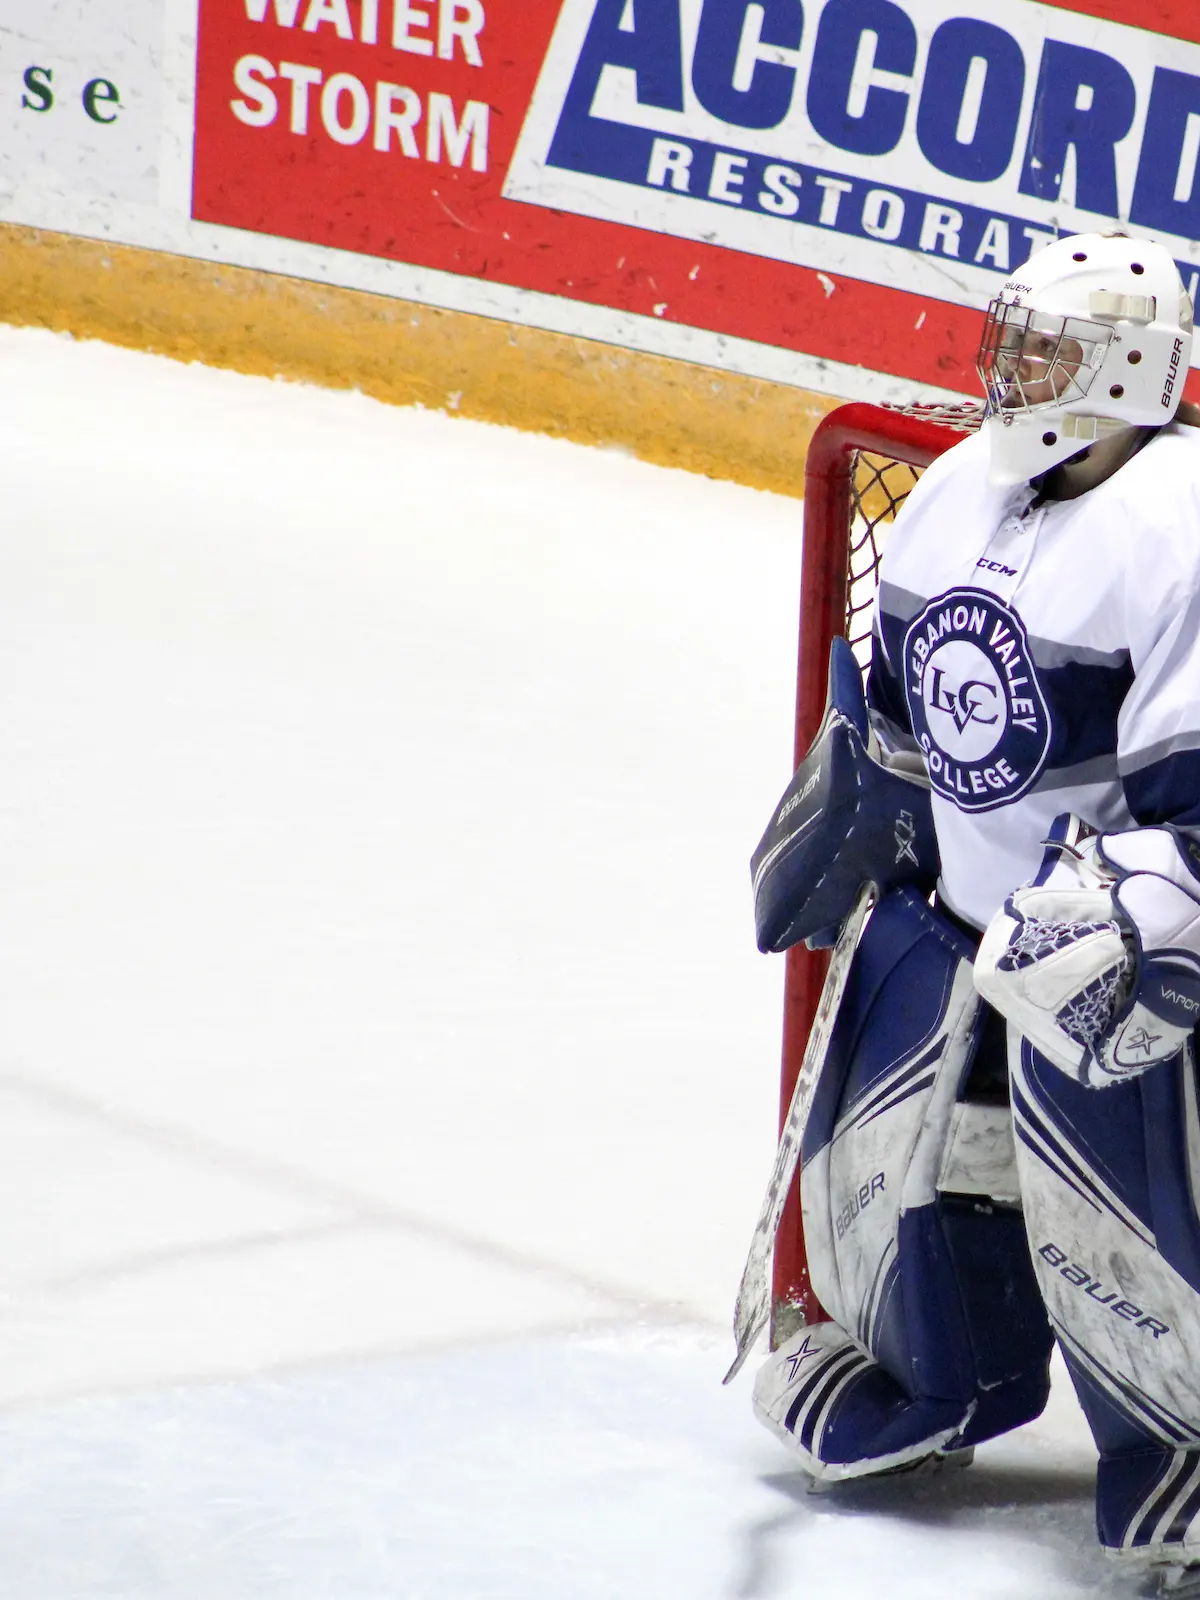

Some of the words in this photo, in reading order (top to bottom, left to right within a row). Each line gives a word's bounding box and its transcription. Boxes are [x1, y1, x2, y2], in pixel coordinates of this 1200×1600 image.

[230, 54, 489, 173] STORM
[976, 557, 1018, 577] CCM
[912, 606, 987, 696] LEBANON
[988, 618, 1038, 734] VALLEY
[930, 666, 999, 735] LVC
[1161, 984, 1200, 1013] VAPOR
